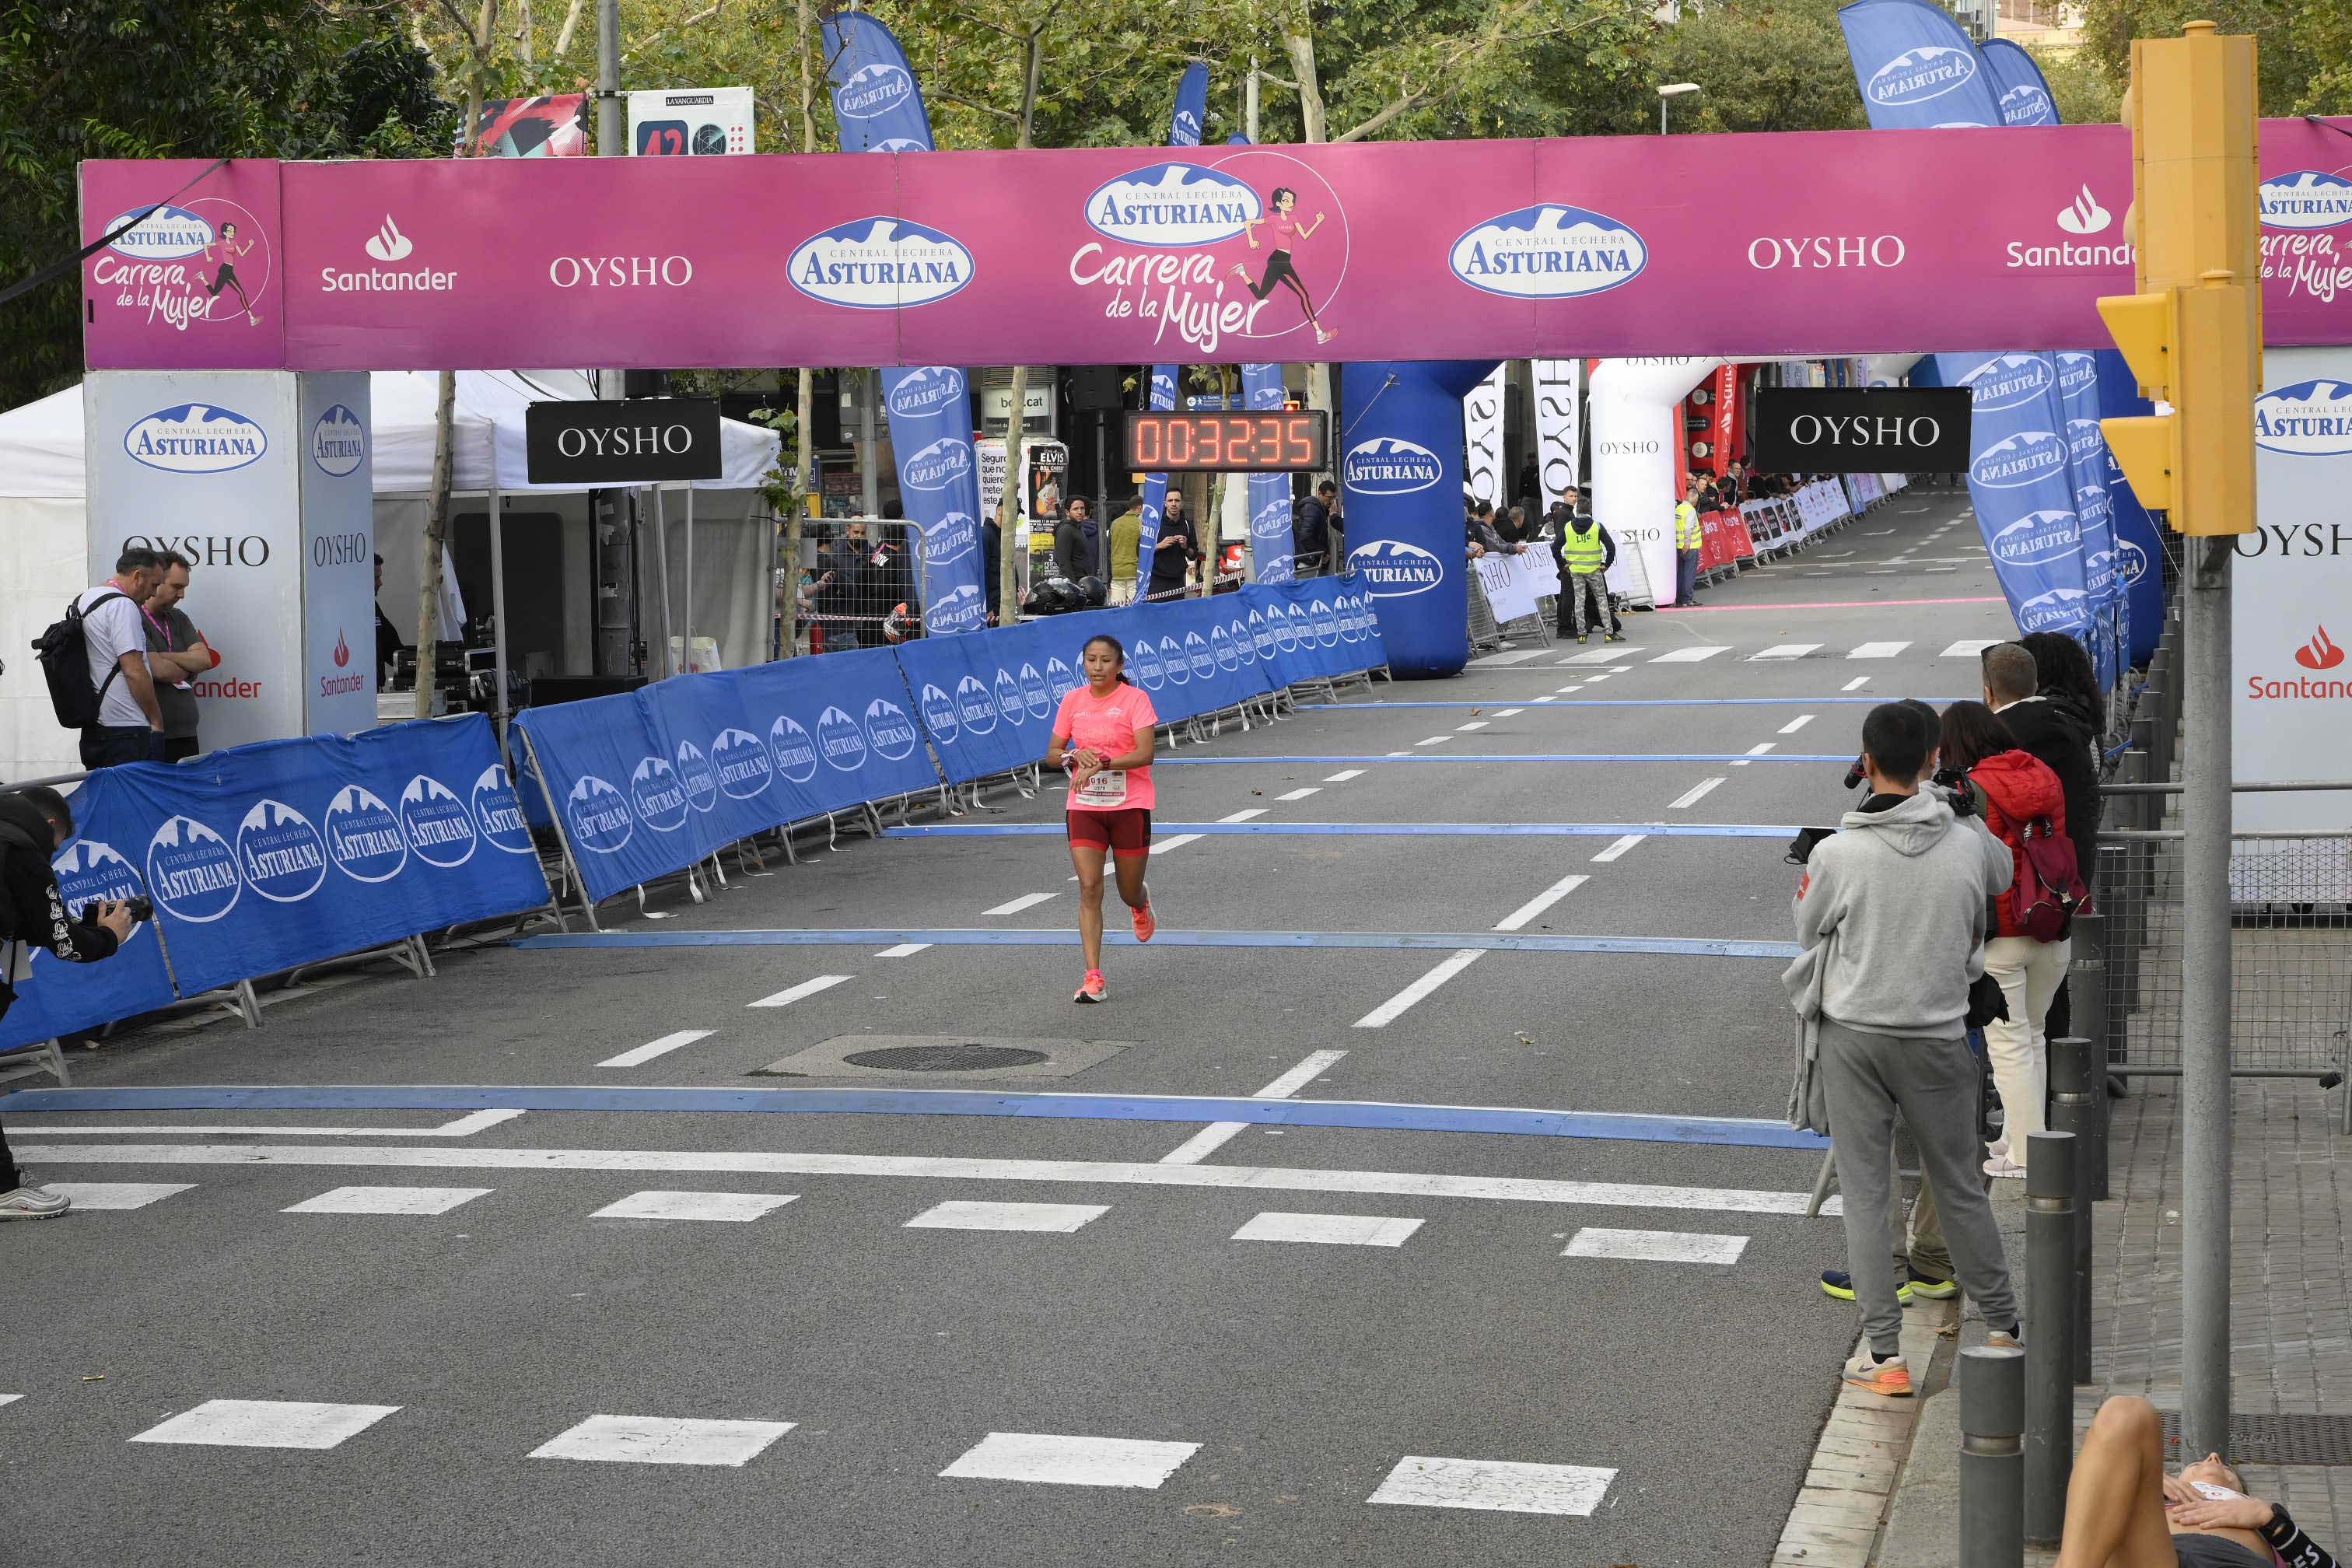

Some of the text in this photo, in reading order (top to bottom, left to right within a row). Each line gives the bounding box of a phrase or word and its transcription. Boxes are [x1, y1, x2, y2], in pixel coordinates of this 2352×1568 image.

[1098, 194, 1246, 226] ASTURIANA
[1125, 191, 1243, 200] CENTRAL LECHERA
[830, 248, 953, 258] CENTRAL LECHERA
[1495, 235, 1626, 247] CENTRAL LECHERA
[1748, 235, 1906, 269] OYSHO
[2007, 242, 2137, 268] Santand
[2259, 234, 2334, 257] arrera
[94, 257, 186, 285] Carrera
[549, 255, 693, 288] OYSHO
[801, 251, 960, 286] ASTURIANA
[1069, 242, 1217, 285] Carrera
[1465, 240, 1633, 275] ASTURIANA
[321, 268, 457, 292] Santander
[2278, 256, 2291, 278] la
[2288, 255, 2352, 303] Muje
[117, 285, 220, 331] de la Mujer
[1105, 281, 1269, 353] de la Mujer
[135, 429, 257, 456] ASTURIANA
[317, 431, 362, 459] ASTURIANA
[558, 425, 692, 457] OYSHO
[1137, 419, 1311, 463] 00:32:35
[1790, 415, 1940, 446] OYSHO
[1040, 453, 1064, 463] ELVIS
[1600, 440, 1659, 456] OYSHO
[1347, 460, 1434, 482] ASTURIANA
[314, 532, 366, 567] OYSHO
[1576, 533, 1591, 544] Life
[2234, 523, 2352, 558] OYSH
[194, 677, 261, 698] ander
[320, 672, 364, 698] Santander
[775, 744, 815, 768] ASTURIANA
[824, 733, 864, 757] ASTURIANA
[716, 756, 770, 786] ASTURIANA
[254, 828, 311, 848] CENTRAL LECHERA
[332, 825, 404, 862] ASTURIANA
[407, 813, 473, 848] ASTURIANA
[166, 846, 225, 866] CENTRAL LECHERA
[246, 842, 323, 881] ASTURIANA
[156, 859, 237, 901] ASTURIANA
